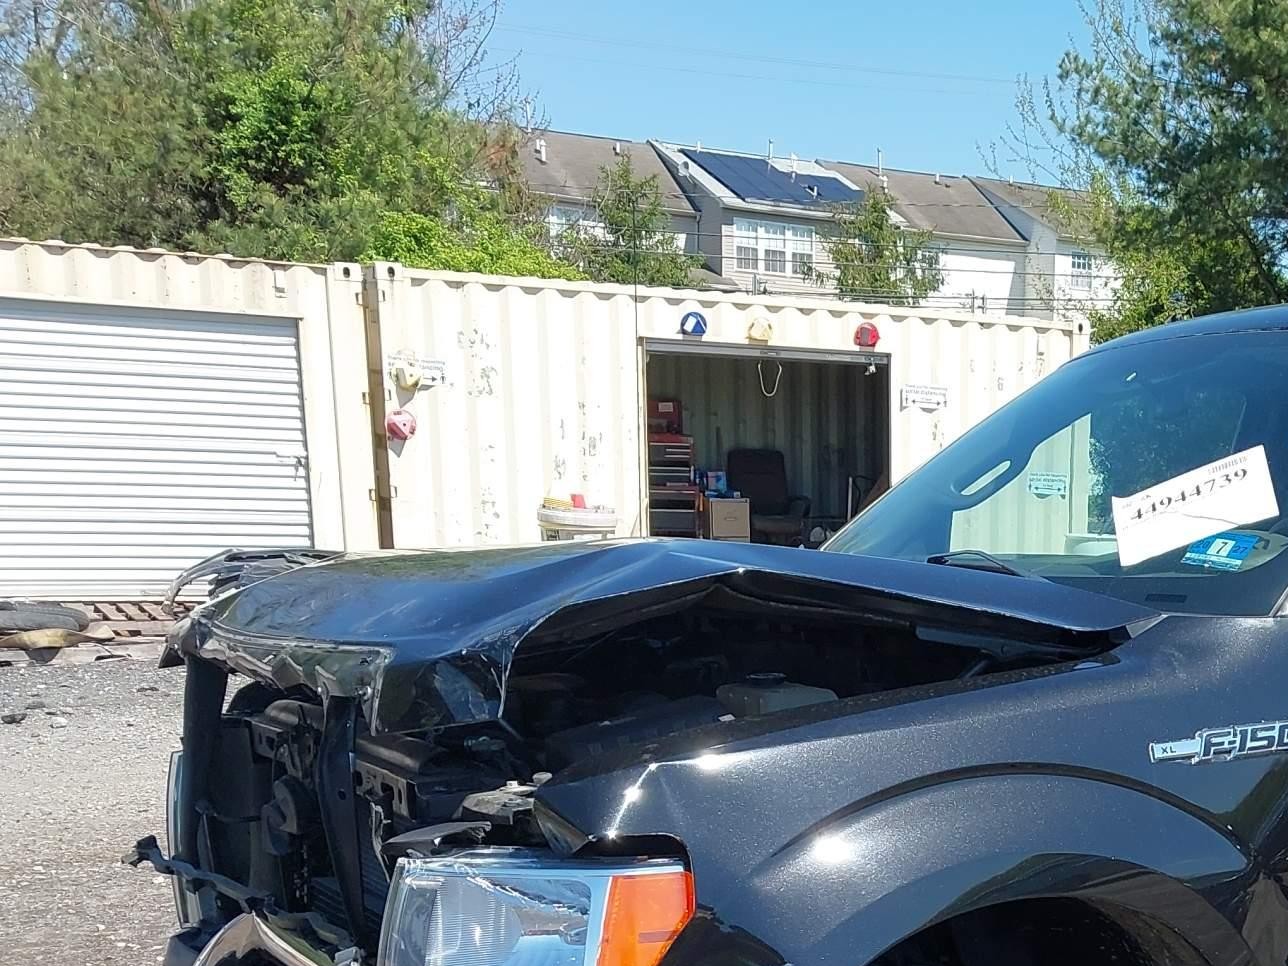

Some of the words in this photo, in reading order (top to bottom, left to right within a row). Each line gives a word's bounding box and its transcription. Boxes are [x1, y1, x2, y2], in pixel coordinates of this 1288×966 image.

[1130, 467, 1248, 520] 44944739
[1215, 541, 1229, 555] 7
[1232, 545, 1248, 555] 27
[1160, 745, 1177, 755] XL
